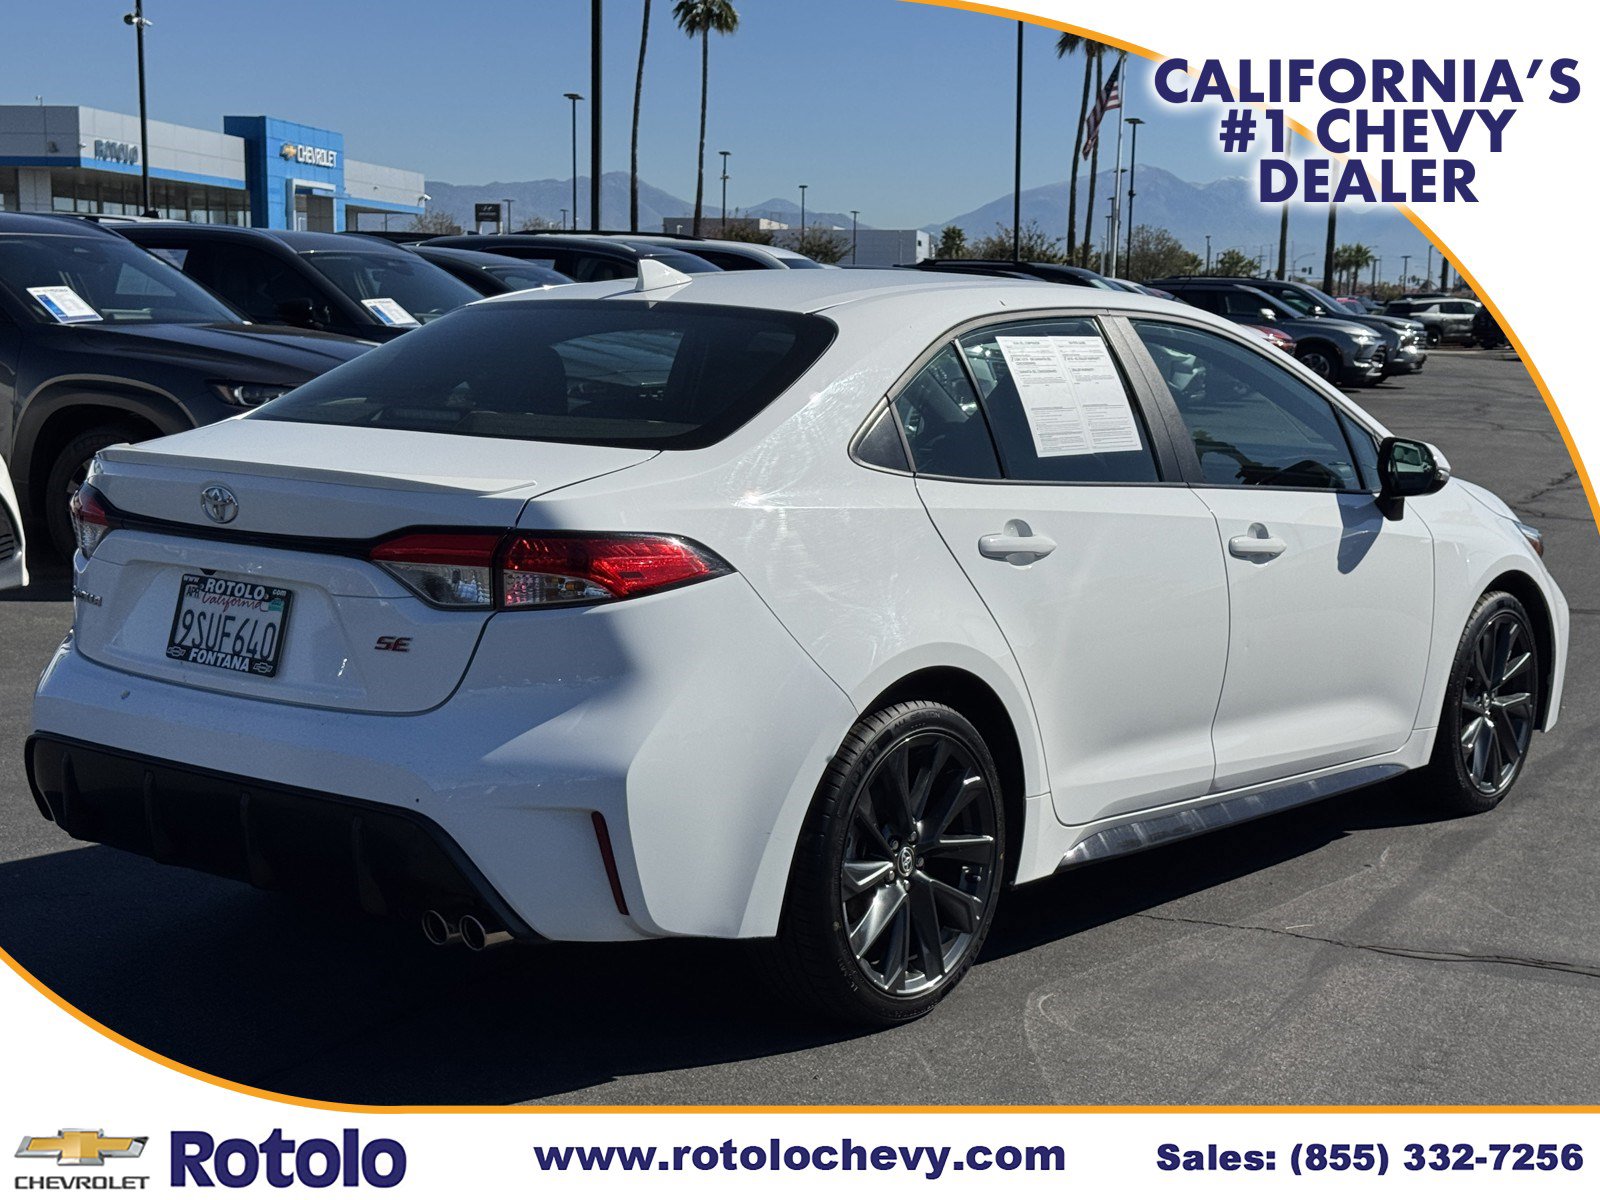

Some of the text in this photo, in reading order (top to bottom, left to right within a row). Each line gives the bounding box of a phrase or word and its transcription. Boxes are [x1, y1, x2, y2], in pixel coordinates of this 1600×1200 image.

[297, 144, 337, 168] CHEVROLET
[204, 578, 266, 600] ROTOLO
[178, 608, 277, 661] 9SUF640
[374, 635, 413, 652] SE
[188, 647, 251, 672] FONTANA
